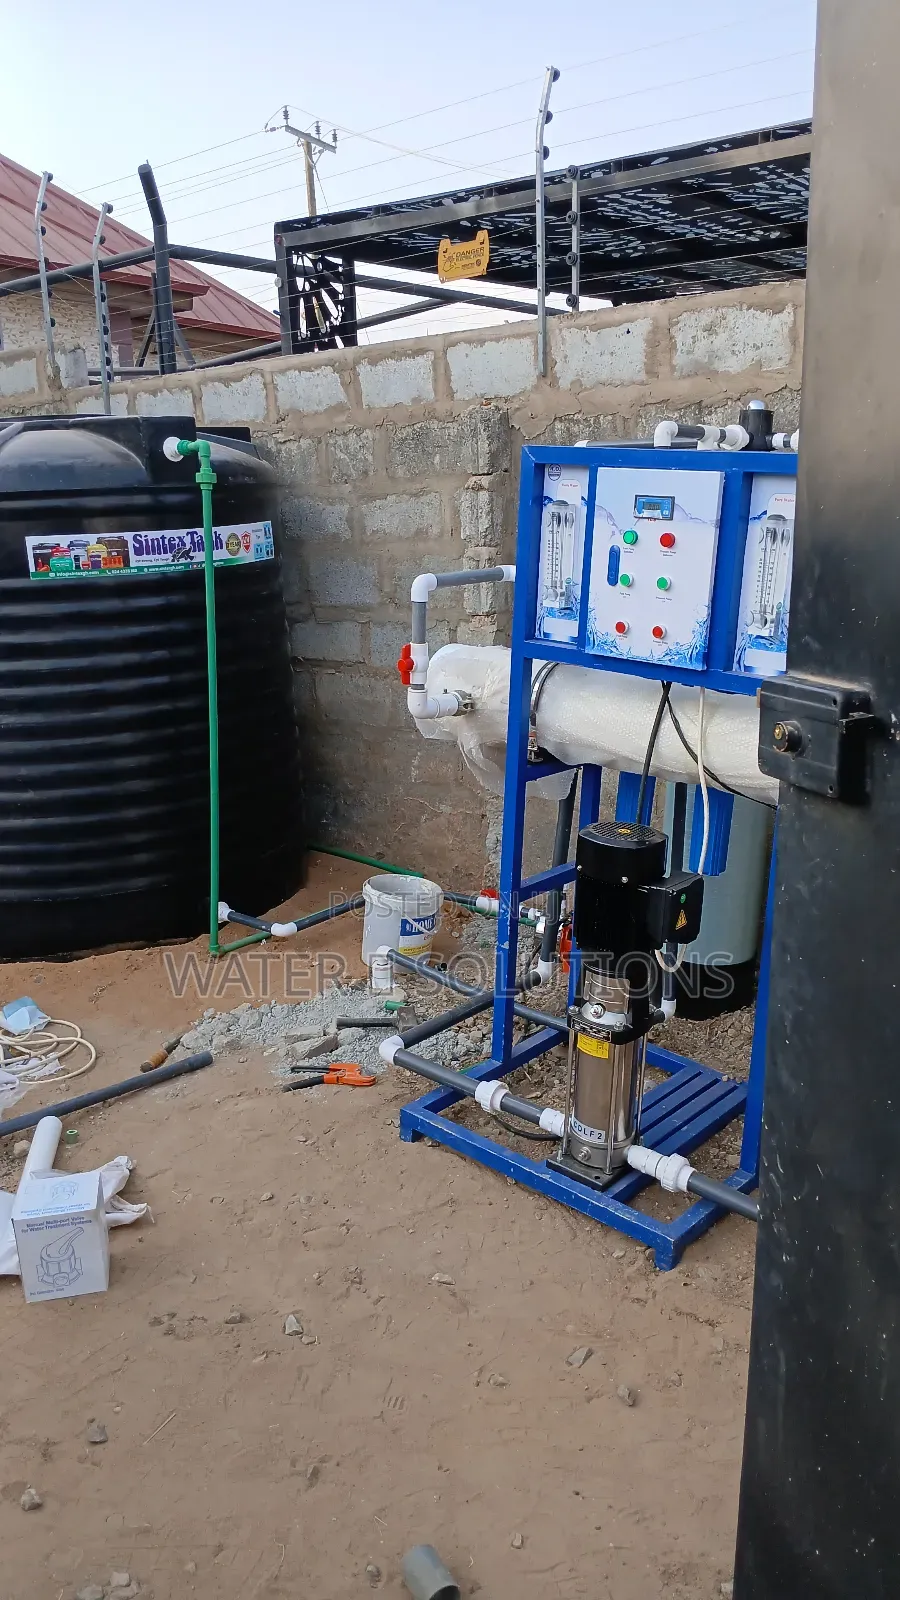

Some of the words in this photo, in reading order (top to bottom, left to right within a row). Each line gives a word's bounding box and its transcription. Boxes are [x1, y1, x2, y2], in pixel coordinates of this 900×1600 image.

[455, 247, 485, 258] DANGER
[573, 1120, 595, 1138] CDLF
[597, 1132, 603, 1140] 2
